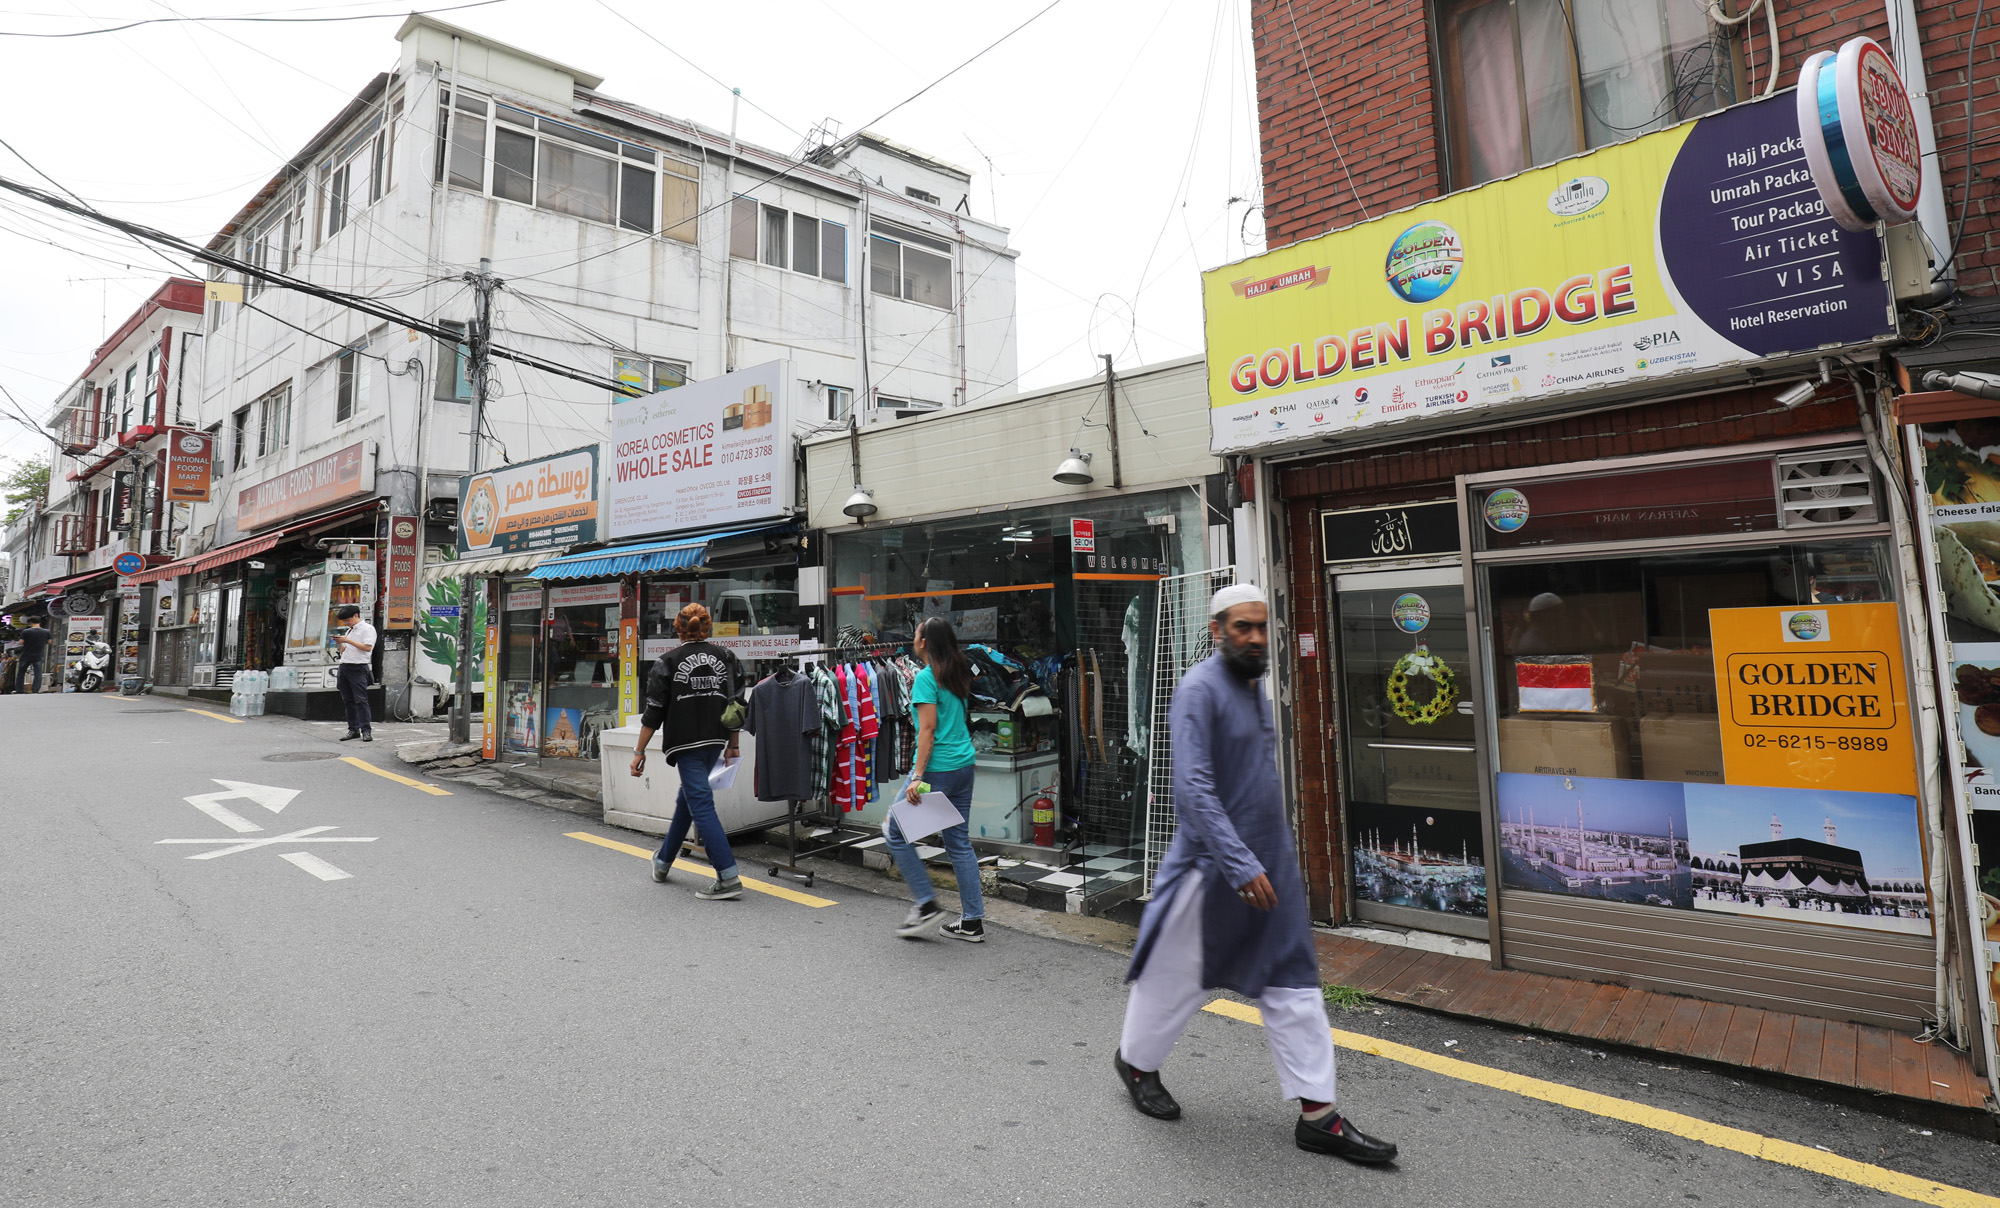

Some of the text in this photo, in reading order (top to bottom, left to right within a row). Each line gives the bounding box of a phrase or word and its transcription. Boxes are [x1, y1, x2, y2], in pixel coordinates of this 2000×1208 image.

[1869, 71, 1905, 123] IBNU
[1877, 117, 1912, 166] SINA
[1727, 136, 1804, 168] Hajj Packa
[1710, 179, 1760, 204] Umrah
[1553, 215, 1586, 228] Authorized
[1731, 199, 1825, 231] Tour Packag
[1393, 236, 1455, 260] GOLDEN
[1745, 228, 1839, 261] Air Ticket
[1397, 264, 1453, 287] BRIDGE
[1777, 260, 1844, 287] VISA
[1247, 270, 1311, 296] HAJJ UMRAH
[1730, 299, 1848, 331] Hotel Reservation
[1229, 263, 1638, 395] GOLDEN BRIDGE
[1653, 330, 1681, 346] PIA
[1599, 347, 1623, 356] AIRLINES
[1649, 351, 1697, 365] UZBEKISTAN
[1677, 358, 1698, 366] airways
[1476, 364, 1529, 379] CATHAY PACIFIC
[1556, 366, 1625, 385] CHINA AIRLINES
[1414, 374, 1455, 388] Ethiopian
[1306, 398, 1330, 410] QATAR
[1425, 392, 1455, 402] TURKISH
[1425, 399, 1455, 408] AIRLINES
[1278, 404, 1297, 414] THAI
[1381, 400, 1417, 414] Emirates
[616, 438, 649, 459] KOREA
[651, 422, 714, 450] COSMETICS
[171, 455, 209, 465] NATIONAL
[721, 444, 773, 464] 010 4728 3788
[177, 464, 203, 473] FOODS
[616, 443, 713, 483] WHOLE SALE
[178, 473, 201, 481] MART
[256, 476, 287, 510] NATIONAL
[289, 465, 314, 498] FOODS
[315, 456, 338, 489] MART
[504, 464, 589, 513] بوسطة مصر
[1489, 497, 1524, 507] GOLDEN
[1491, 512, 1523, 521] BRIDGE
[1936, 507, 1977, 517] Cheese
[391, 545, 415, 556] NATIONAL
[1074, 538, 1093, 547] SECOM
[393, 561, 411, 572] FOODS
[1087, 555, 1158, 570] WELCOME
[394, 577, 409, 588] MART
[721, 639, 751, 648] COSMETICS
[753, 639, 773, 648] WHOLE
[774, 638, 789, 646] SALE
[623, 625, 633, 714] PYRAM
[1739, 662, 1877, 686] GOLDEN
[487, 629, 495, 751] PYRAMIDS
[1748, 694, 1881, 718] BRIDGE
[1744, 733, 1888, 752] 02-6215-8989
